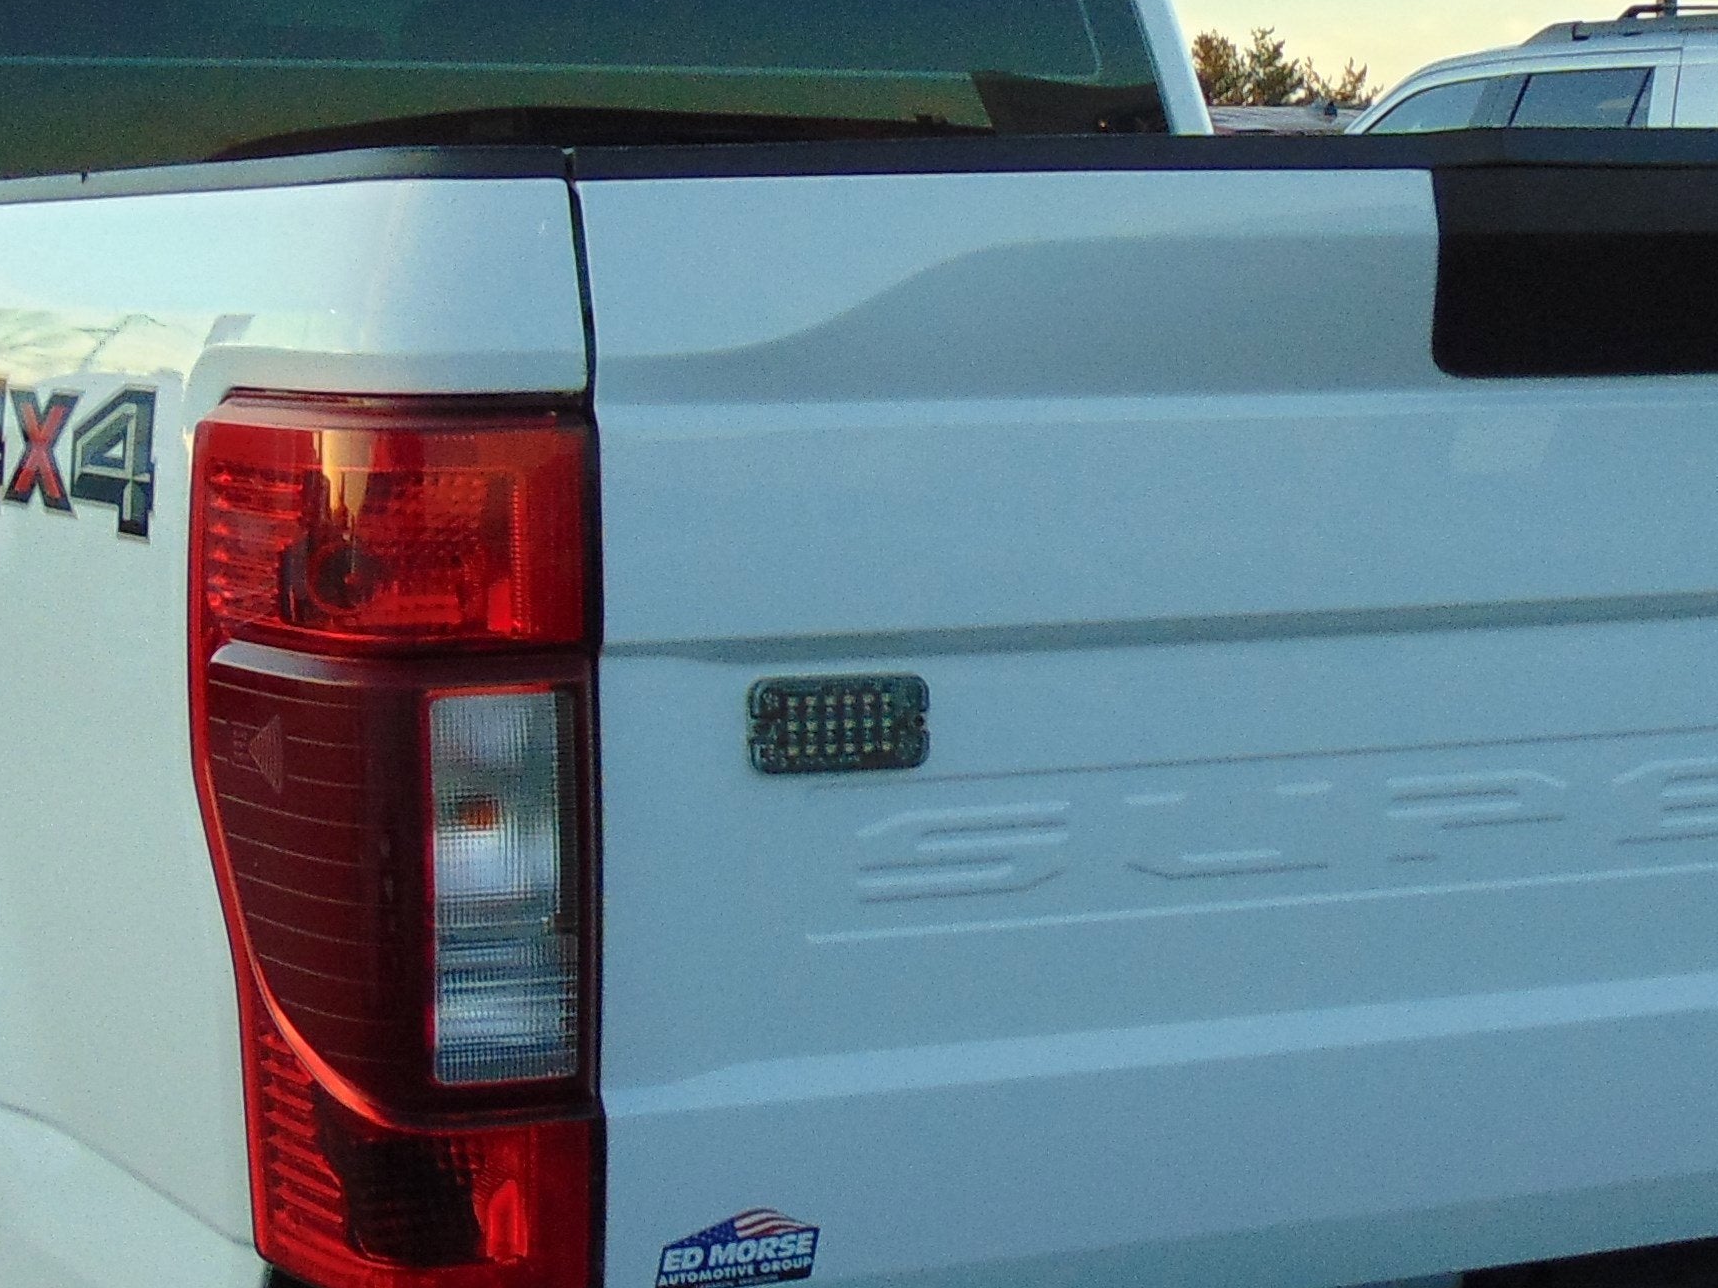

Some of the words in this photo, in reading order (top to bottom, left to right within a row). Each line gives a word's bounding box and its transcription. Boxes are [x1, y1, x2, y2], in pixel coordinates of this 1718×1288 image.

[663, 1247, 705, 1272] ED
[710, 1232, 814, 1265] MORSE
[658, 1265, 755, 1287] AUTOMOTIVE
[760, 1257, 813, 1273] GROUP
